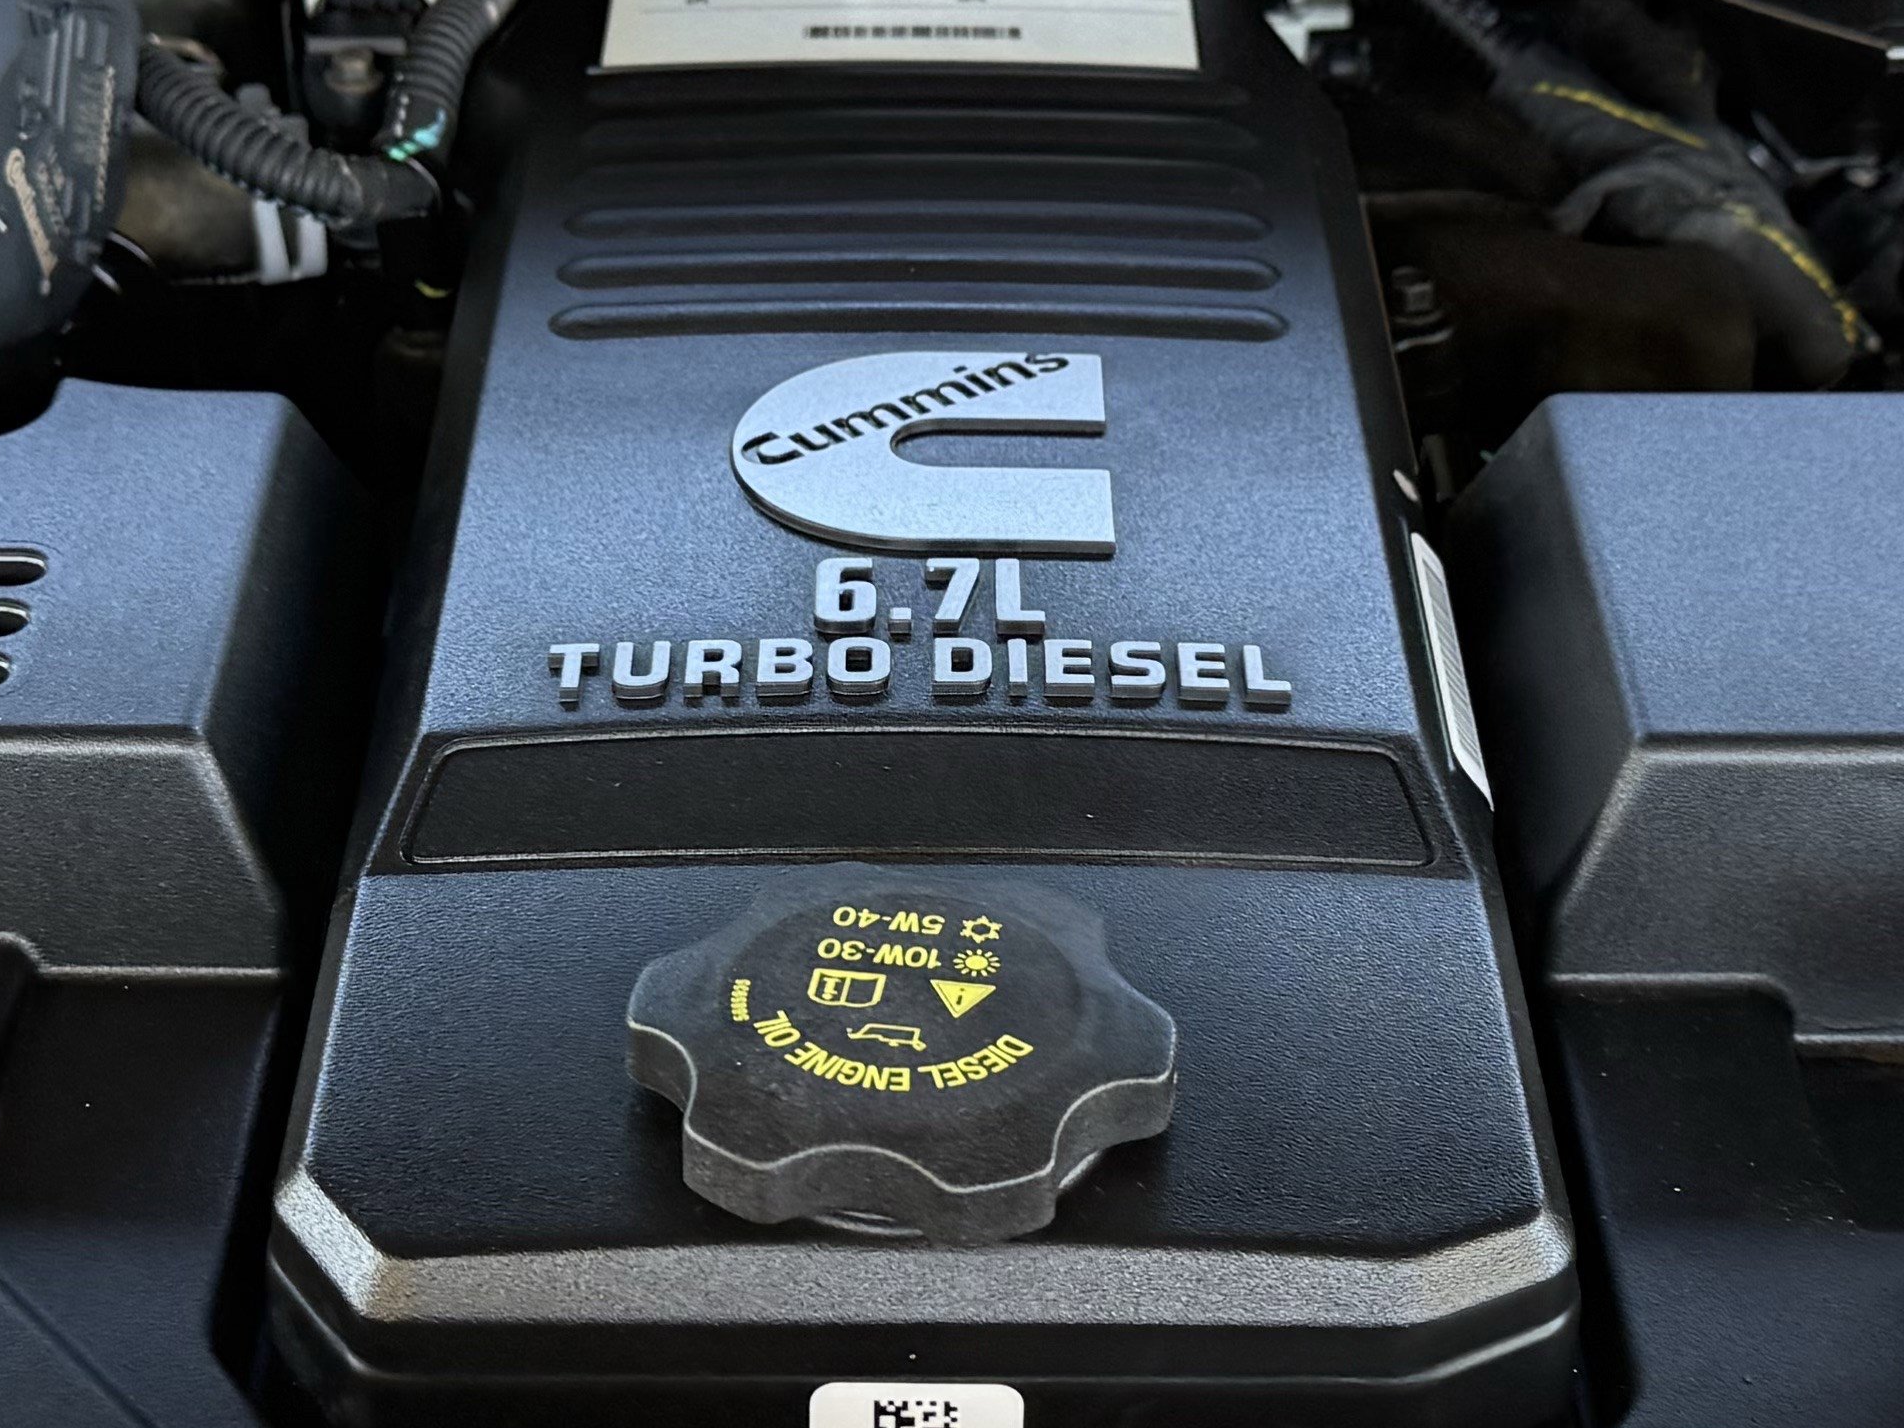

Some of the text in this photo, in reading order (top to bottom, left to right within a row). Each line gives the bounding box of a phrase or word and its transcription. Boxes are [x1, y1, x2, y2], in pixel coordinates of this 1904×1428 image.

[741, 350, 1071, 467] Cummins
[813, 556, 1047, 636] 6.7L
[548, 636, 1293, 709] TURBO DIESEL
[816, 937, 942, 969] 10W-30
[832, 906, 946, 935] 5W-40
[753, 1009, 1035, 1092] DIESEL ENGINE OIL
